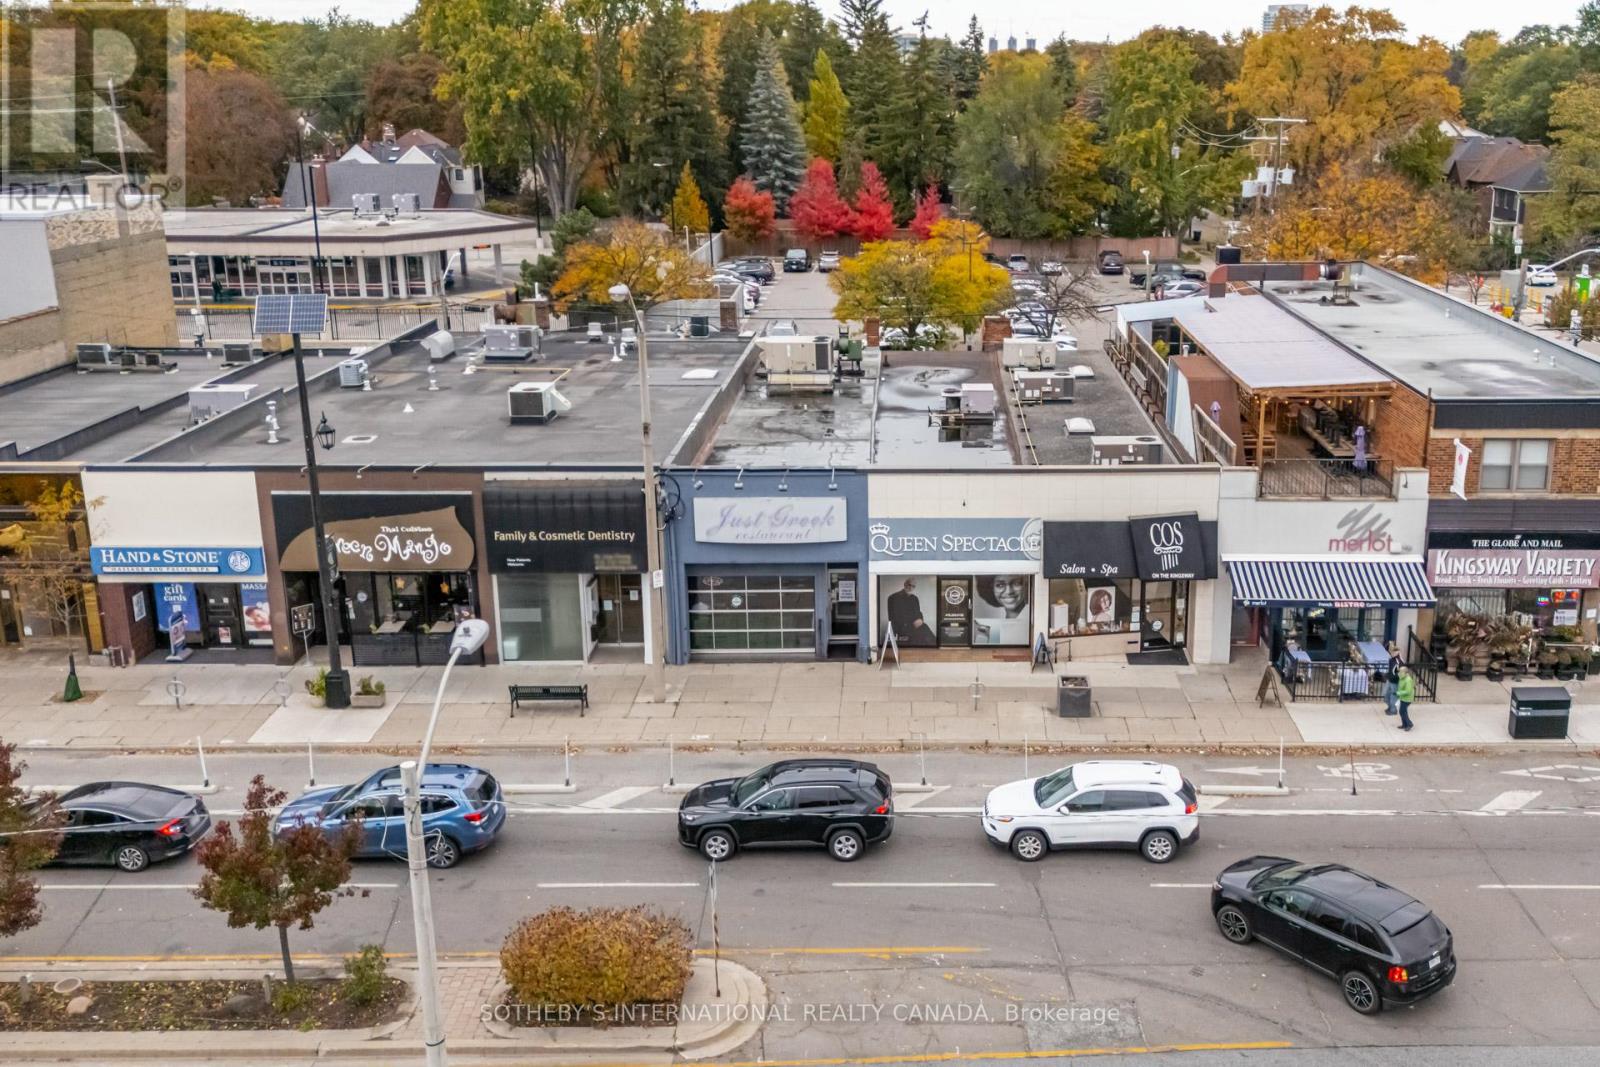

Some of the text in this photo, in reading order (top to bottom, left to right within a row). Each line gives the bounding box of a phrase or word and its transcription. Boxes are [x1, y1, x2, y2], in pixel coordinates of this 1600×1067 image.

[705, 503, 835, 537] Just Greek
[494, 530, 635, 543] Family & Cosmetic Dentistry
[1150, 521, 1184, 547] COS
[1328, 529, 1393, 552] merlot
[326, 533, 453, 564] reen Mango
[870, 533, 938, 557] QUEEN
[1472, 539, 1563, 548] THE GLOBE AND MAIL
[101, 549, 219, 563] HAND & STONE
[1434, 550, 1596, 577] KINGSWAY VARIETY
[1060, 563, 1119, 577] Salon Spa
[163, 593, 188, 602] cards
[164, 583, 184, 596] gift
